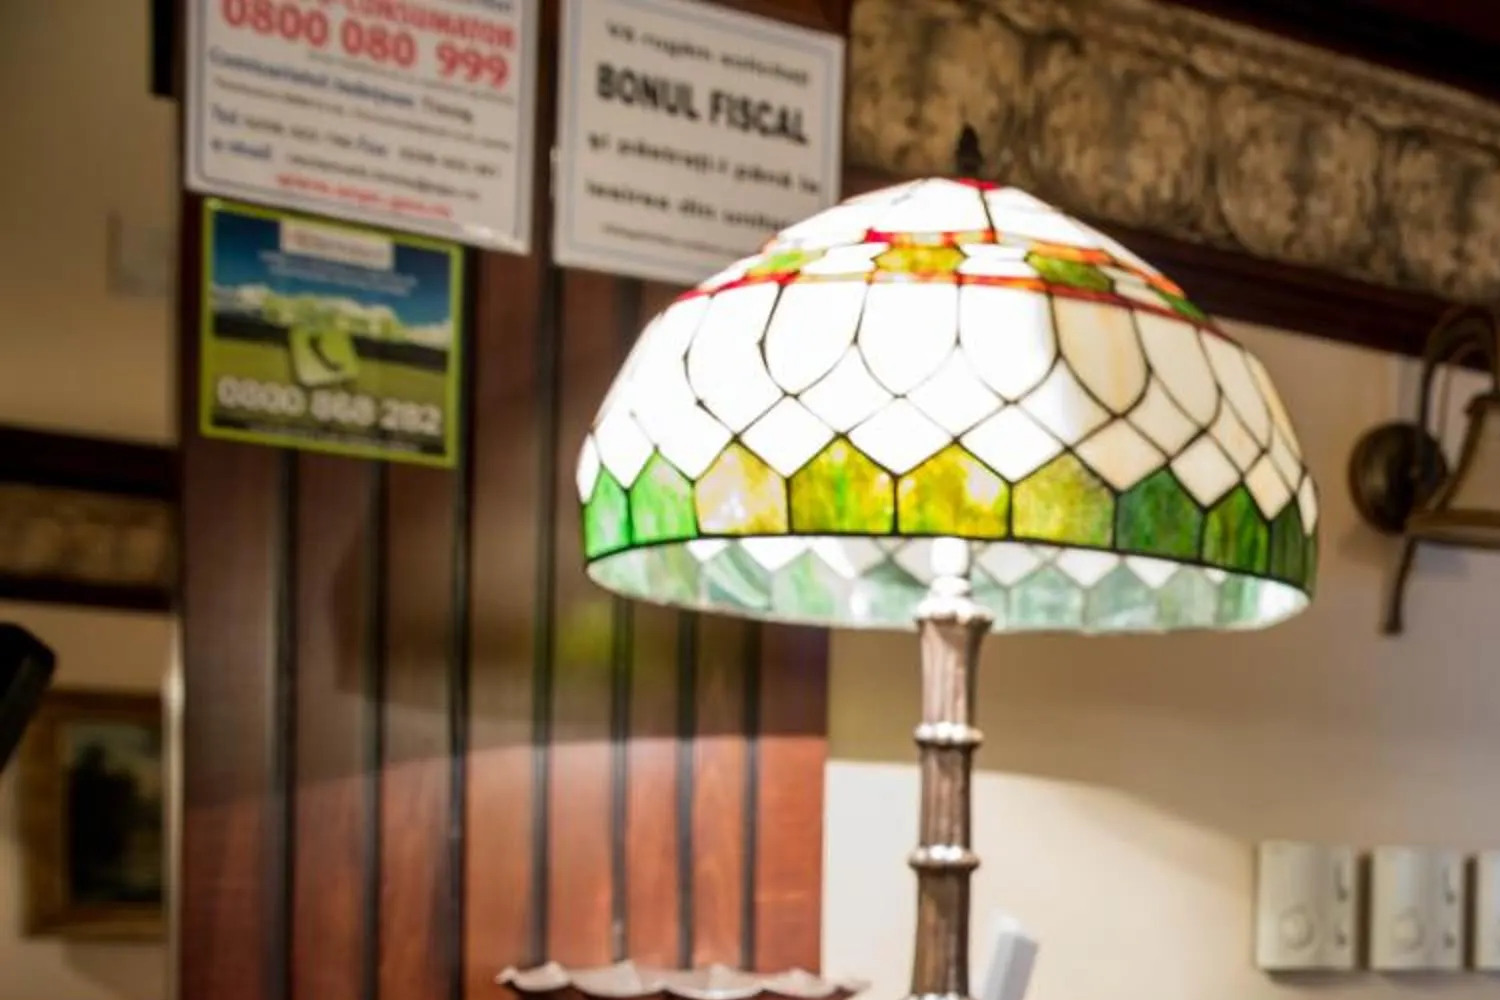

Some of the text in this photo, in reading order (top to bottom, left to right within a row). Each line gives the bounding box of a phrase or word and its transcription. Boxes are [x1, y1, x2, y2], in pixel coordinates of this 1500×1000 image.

[221, 0, 329, 46] 0800
[340, 19, 417, 68] 080
[436, 40, 509, 88] 999
[596, 61, 809, 146] BONUL FISCAL
[217, 376, 306, 417] 0800
